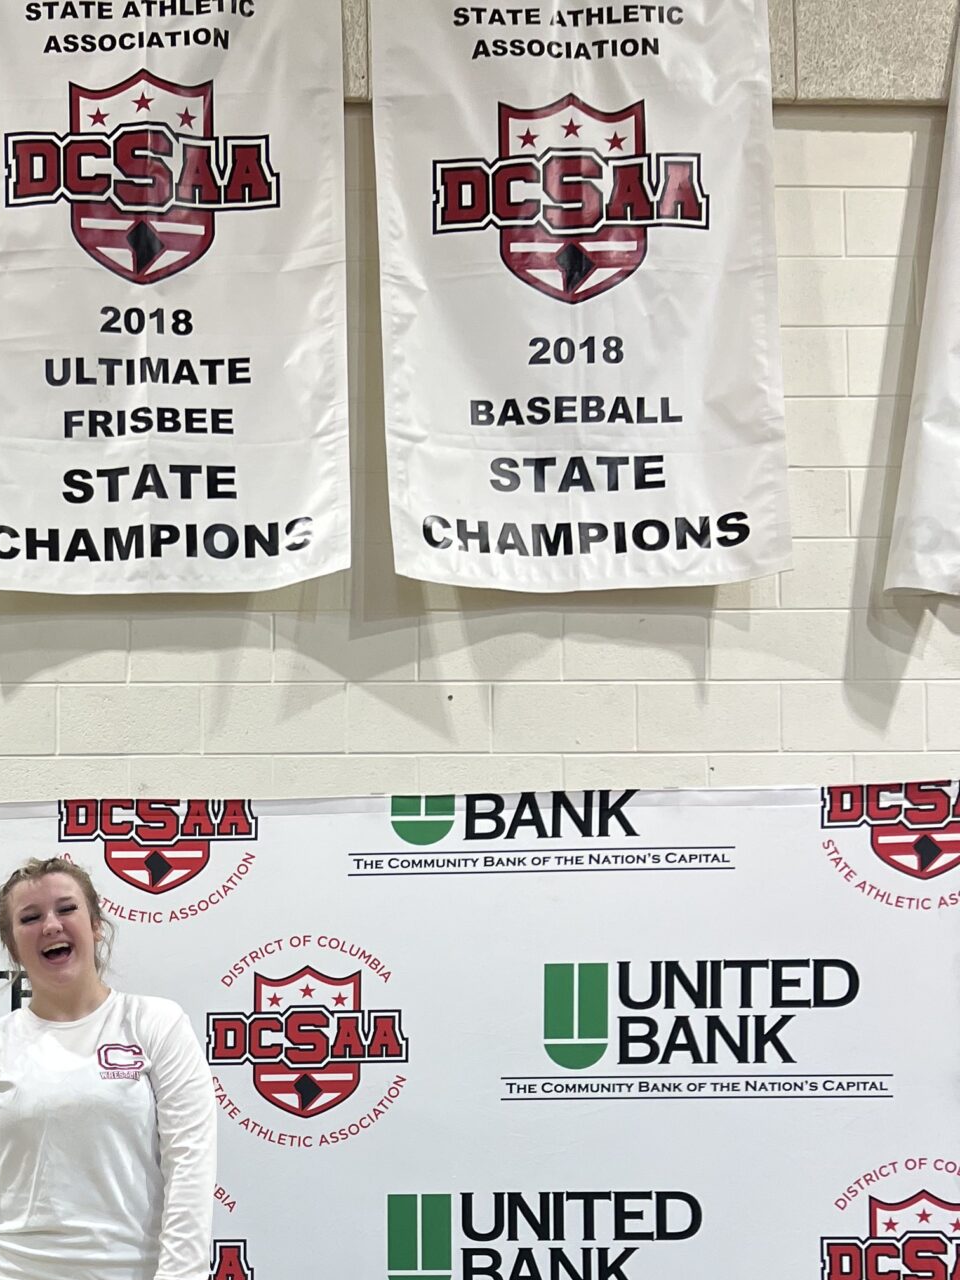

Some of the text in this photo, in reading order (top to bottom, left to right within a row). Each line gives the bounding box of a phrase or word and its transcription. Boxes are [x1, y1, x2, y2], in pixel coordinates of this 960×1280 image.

[26, 0, 254, 21] STATE ATHLETIC
[454, 5, 683, 27] STATE ATHLETIC
[44, 28, 229, 53] ASSOCIATION
[472, 38, 659, 60] ASSOCIATION
[4, 122, 280, 214] DCSAA
[432, 145, 710, 234] DCSAA
[100, 307, 193, 335] 2018
[529, 336, 623, 364] 2018
[46, 357, 251, 386] ULTIMATE
[64, 407, 233, 438] FRISBEE
[471, 396, 682, 425] BASEBALL
[63, 464, 236, 503] STATE
[491, 455, 665, 492] STATE
[423, 512, 750, 556] CHAMPIONS
[58, 798, 258, 847] DCSAA
[464, 789, 640, 840] BANK
[821, 781, 960, 830] DCS
[353, 859, 383, 869] THE
[388, 858, 479, 868] COMMUNITY
[484, 856, 526, 867] BANK
[532, 857, 551, 865] OF
[555, 856, 584, 865] THE
[665, 853, 730, 863] CAPITAL
[168, 851, 257, 922] ASSOCIATION
[219, 933, 392, 989] DISTRICT OF COLUMBIA
[617, 959, 859, 1009] UNITED
[206, 1004, 409, 1068] DCSAA
[618, 1015, 796, 1064] BANK
[97, 1044, 144, 1070] C
[99, 1070, 141, 1081] WRESTLI
[506, 1083, 537, 1093] THE
[542, 1082, 634, 1093] COMMUNITY
[639, 1082, 682, 1092] BANK
[687, 1083, 706, 1092] OF
[710, 1083, 740, 1091] THE
[823, 1080, 888, 1091] CAPITAL
[239, 1118, 311, 1149] ATHLETIC
[318, 1074, 406, 1146] ASSOCIATION
[460, 1191, 702, 1241] UNITED
